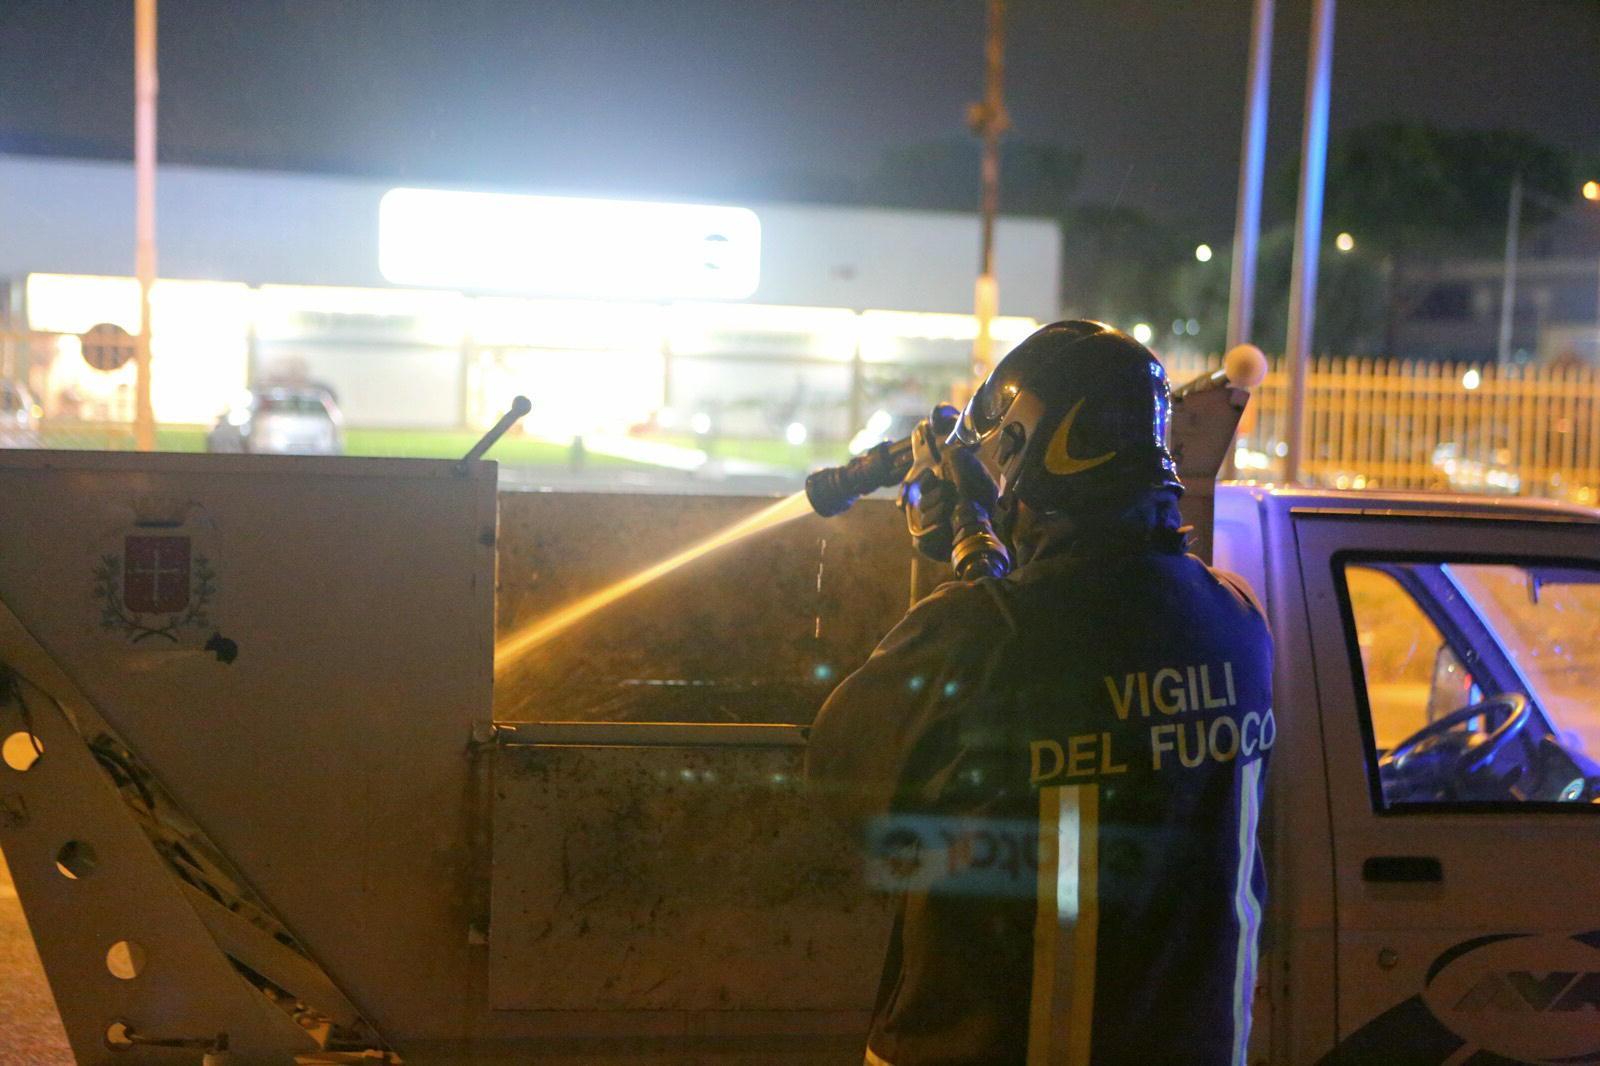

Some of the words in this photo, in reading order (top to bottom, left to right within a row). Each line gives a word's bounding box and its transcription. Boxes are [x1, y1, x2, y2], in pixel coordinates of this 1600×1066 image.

[1104, 661, 1236, 720] VIGILI
[1030, 732, 1127, 784] DEL
[1150, 707, 1277, 770] FUOCO
